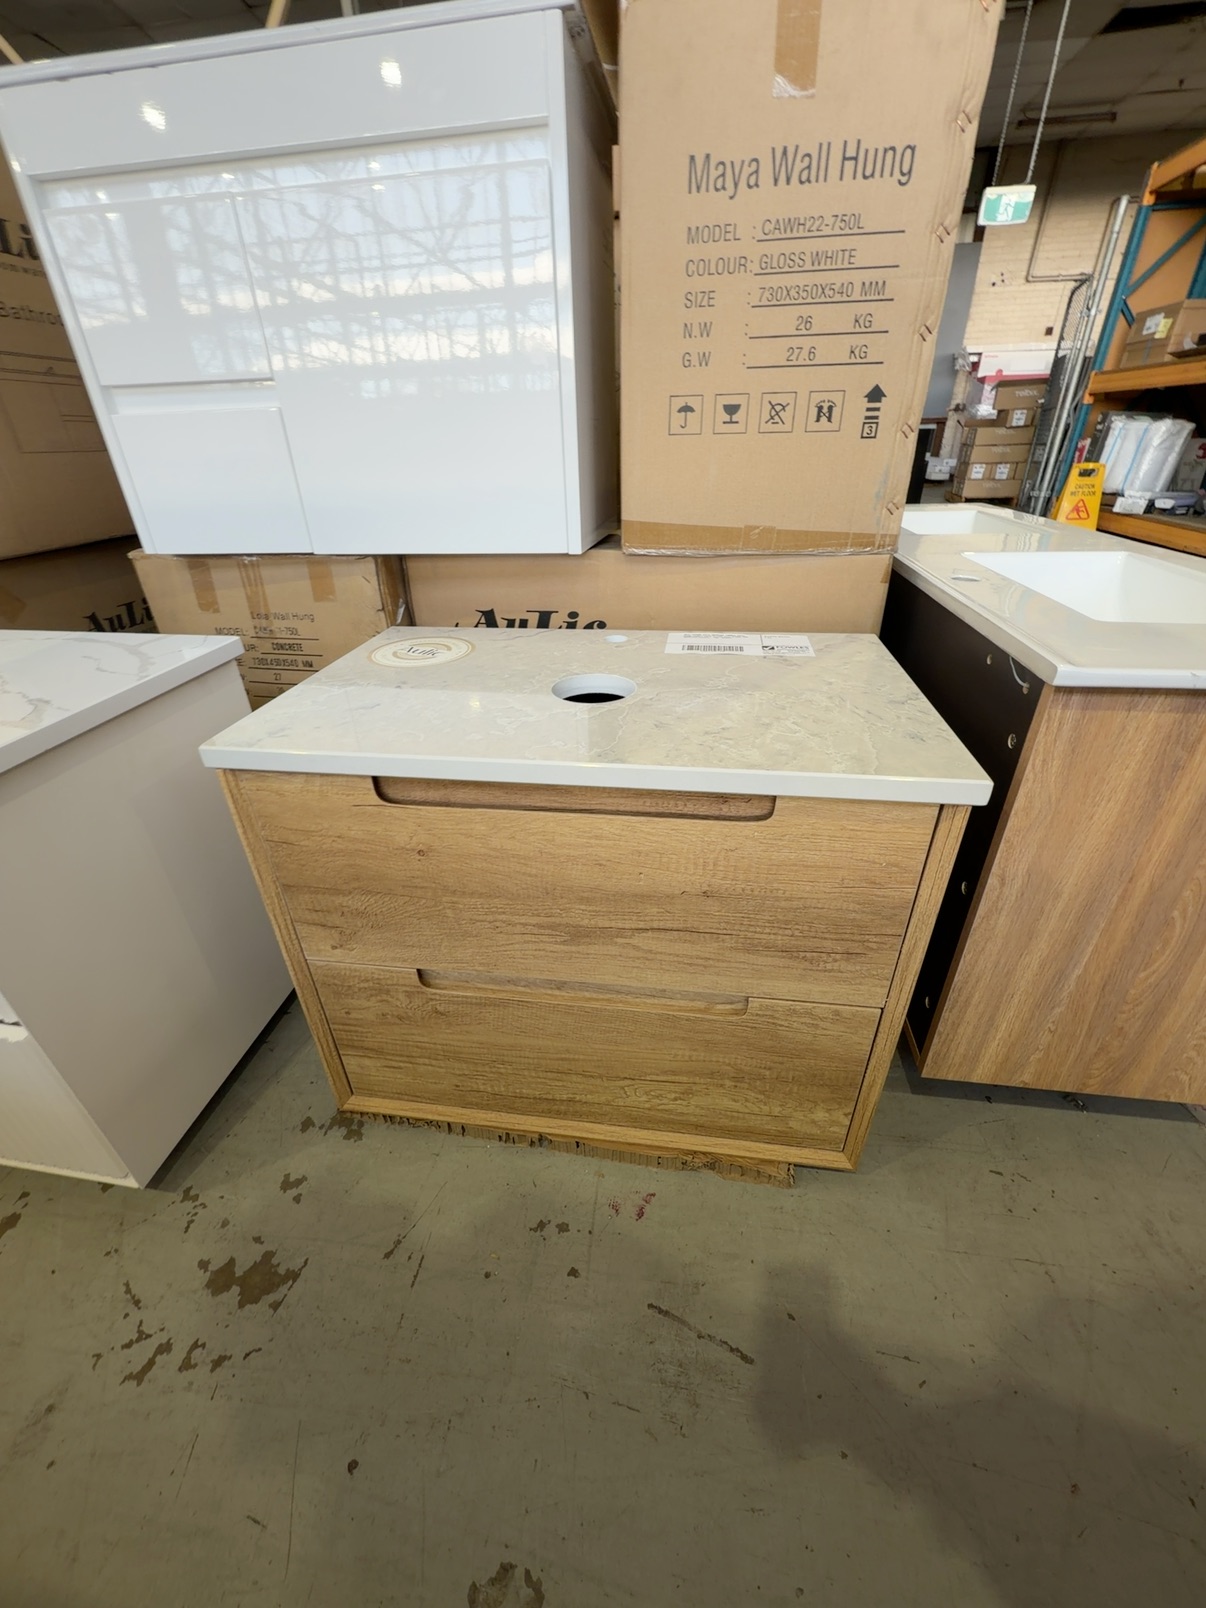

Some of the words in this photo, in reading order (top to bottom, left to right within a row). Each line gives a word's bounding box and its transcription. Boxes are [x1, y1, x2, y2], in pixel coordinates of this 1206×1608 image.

[688, 152, 761, 200] Maya
[771, 141, 832, 188] Wall
[839, 138, 917, 187] Hung
[686, 223, 742, 245] MODEL
[761, 212, 865, 237] CAWH22-750L
[759, 251, 806, 272] GLOSS
[810, 248, 857, 268] WHITE
[684, 290, 716, 310] SIZE
[758, 281, 854, 303] 730X350X540
[860, 280, 886, 298] MM
[683, 321, 713, 340] N.W
[795, 315, 813, 332] 26
[853, 312, 873, 329] KG
[682, 351, 711, 369] G.W
[786, 346, 816, 363] 27.6
[849, 344, 868, 360] KG
[866, 425, 874, 436] 3
[272, 612, 290, 621] Wall
[292, 612, 315, 623] Hung
[271, 642, 304, 652] CONCRETE
[302, 659, 314, 668] MM
